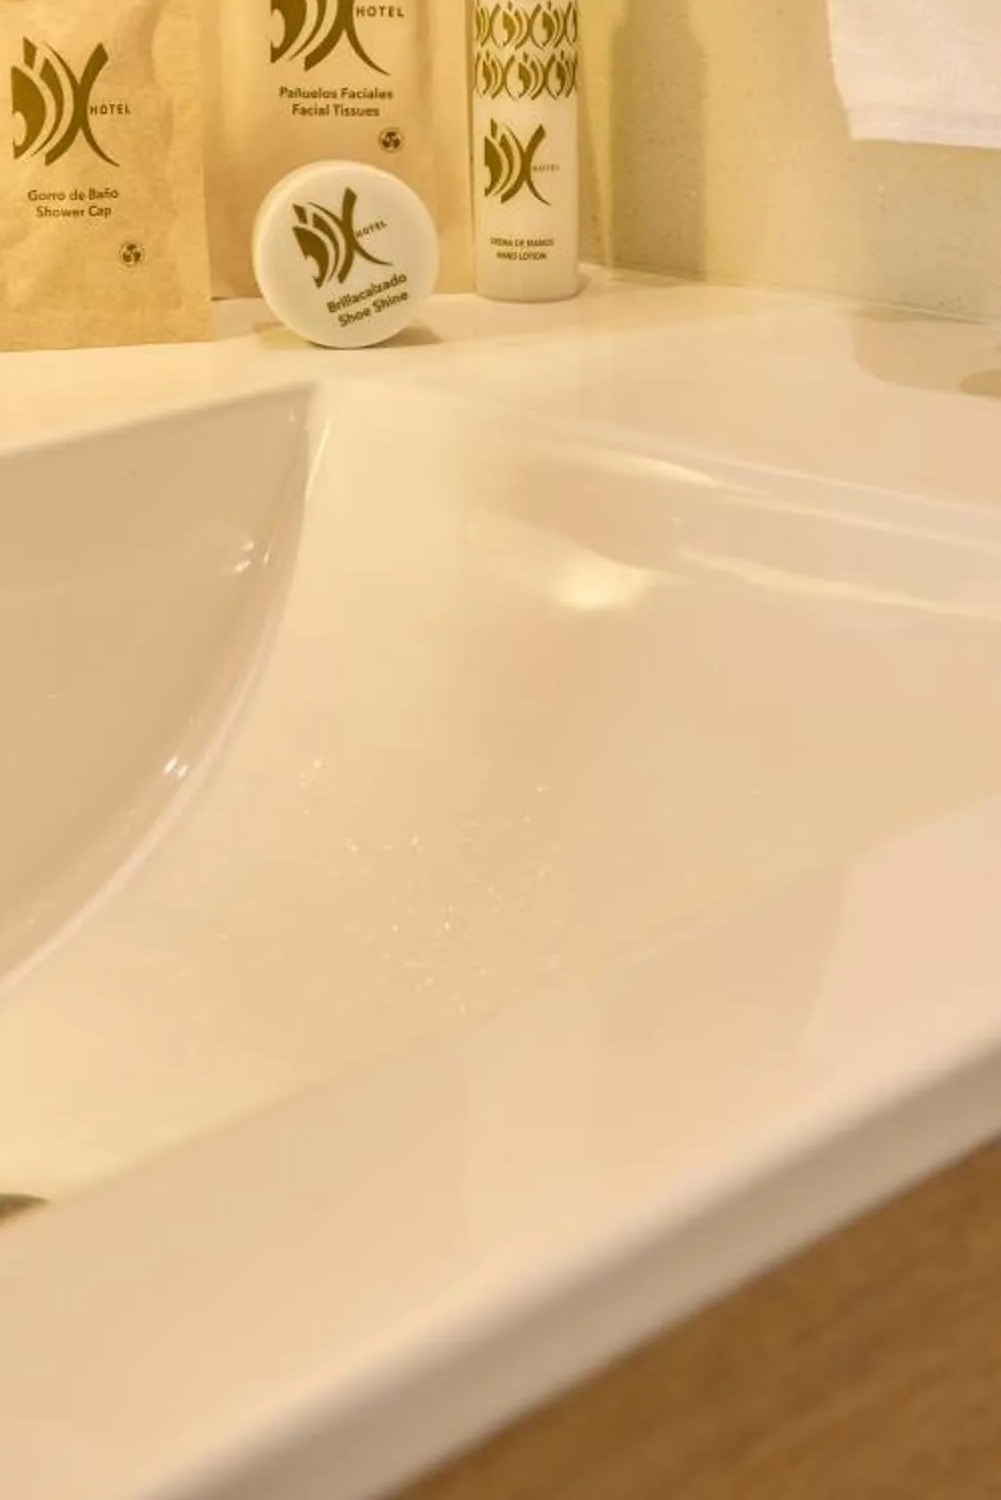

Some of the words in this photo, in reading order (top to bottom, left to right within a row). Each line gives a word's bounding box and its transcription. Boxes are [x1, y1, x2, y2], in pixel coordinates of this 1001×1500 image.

[356, 5, 405, 18] HOTEL
[279, 86, 337, 99] Pañuelos
[340, 87, 394, 100] Faciales
[89, 103, 132, 115] HOTEL
[292, 103, 330, 117] Facial
[332, 103, 380, 117] Tissues
[27, 189, 66, 201] Gorro
[69, 189, 85, 201] de
[88, 187, 119, 201] Baño
[36, 205, 85, 218] Shower
[88, 205, 112, 219] Cap
[356, 219, 388, 238] HOTEL
[326, 273, 408, 314] Brillacalzado
[337, 307, 372, 328] Shoe
[372, 291, 408, 313] Shine
